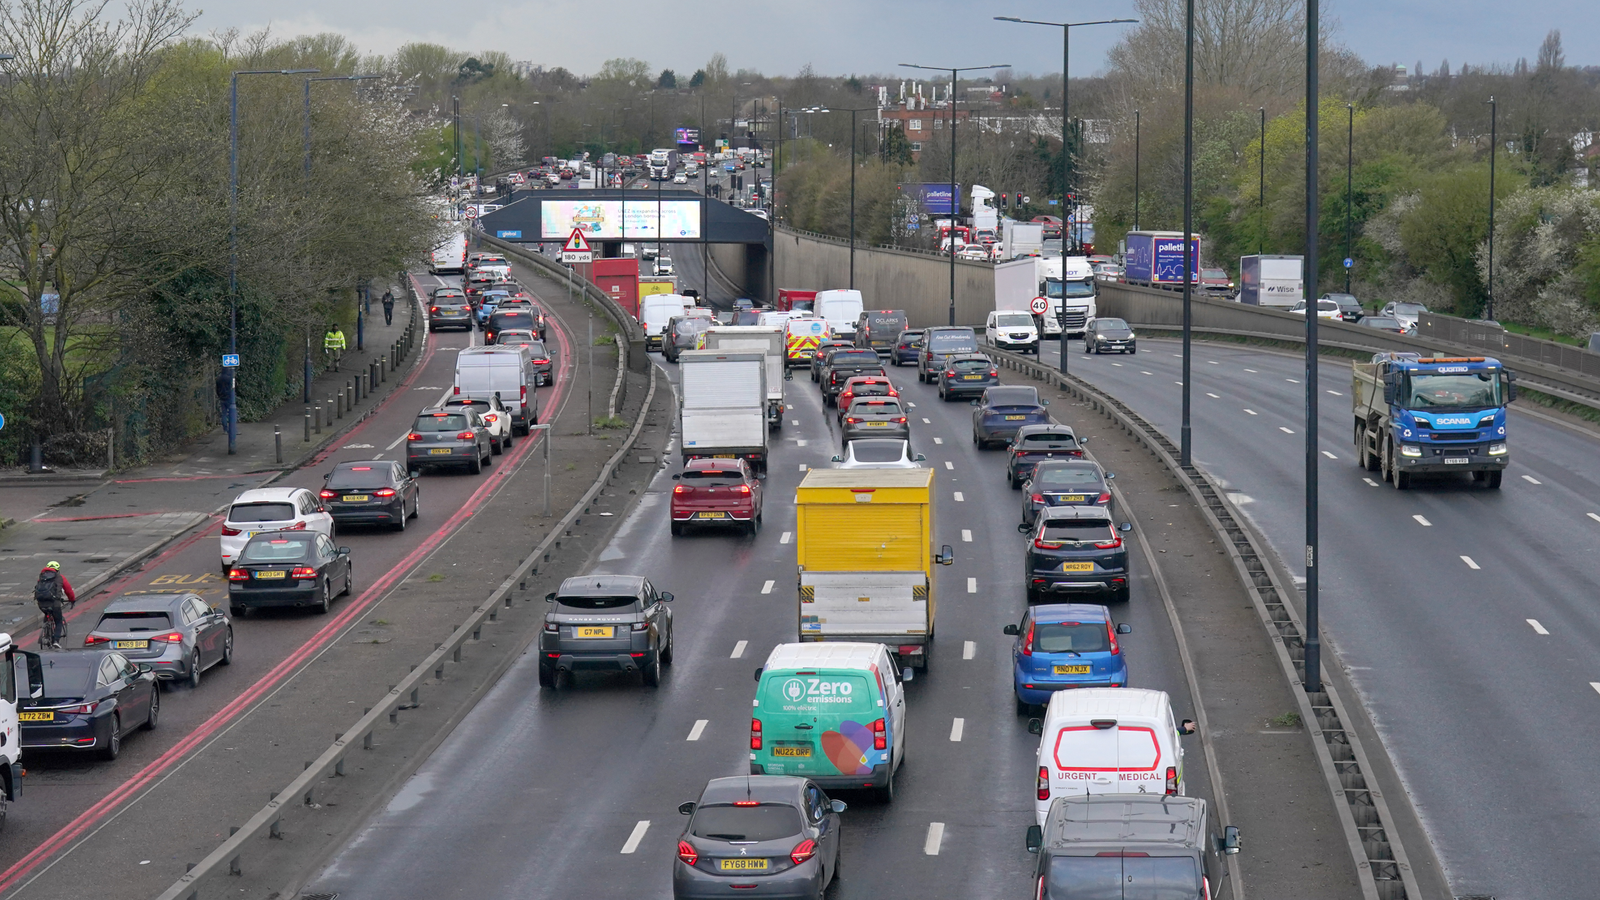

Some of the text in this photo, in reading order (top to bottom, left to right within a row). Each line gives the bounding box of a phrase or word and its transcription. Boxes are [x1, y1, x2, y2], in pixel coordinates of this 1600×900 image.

[1159, 243, 1194, 252] palletlie
[578, 254, 590, 262] yds
[1032, 302, 1046, 310] 40
[807, 678, 852, 694] Zero
[807, 694, 852, 704] emissions
[18, 712, 36, 720] LT72
[1119, 772, 1162, 780] MEDICAL
